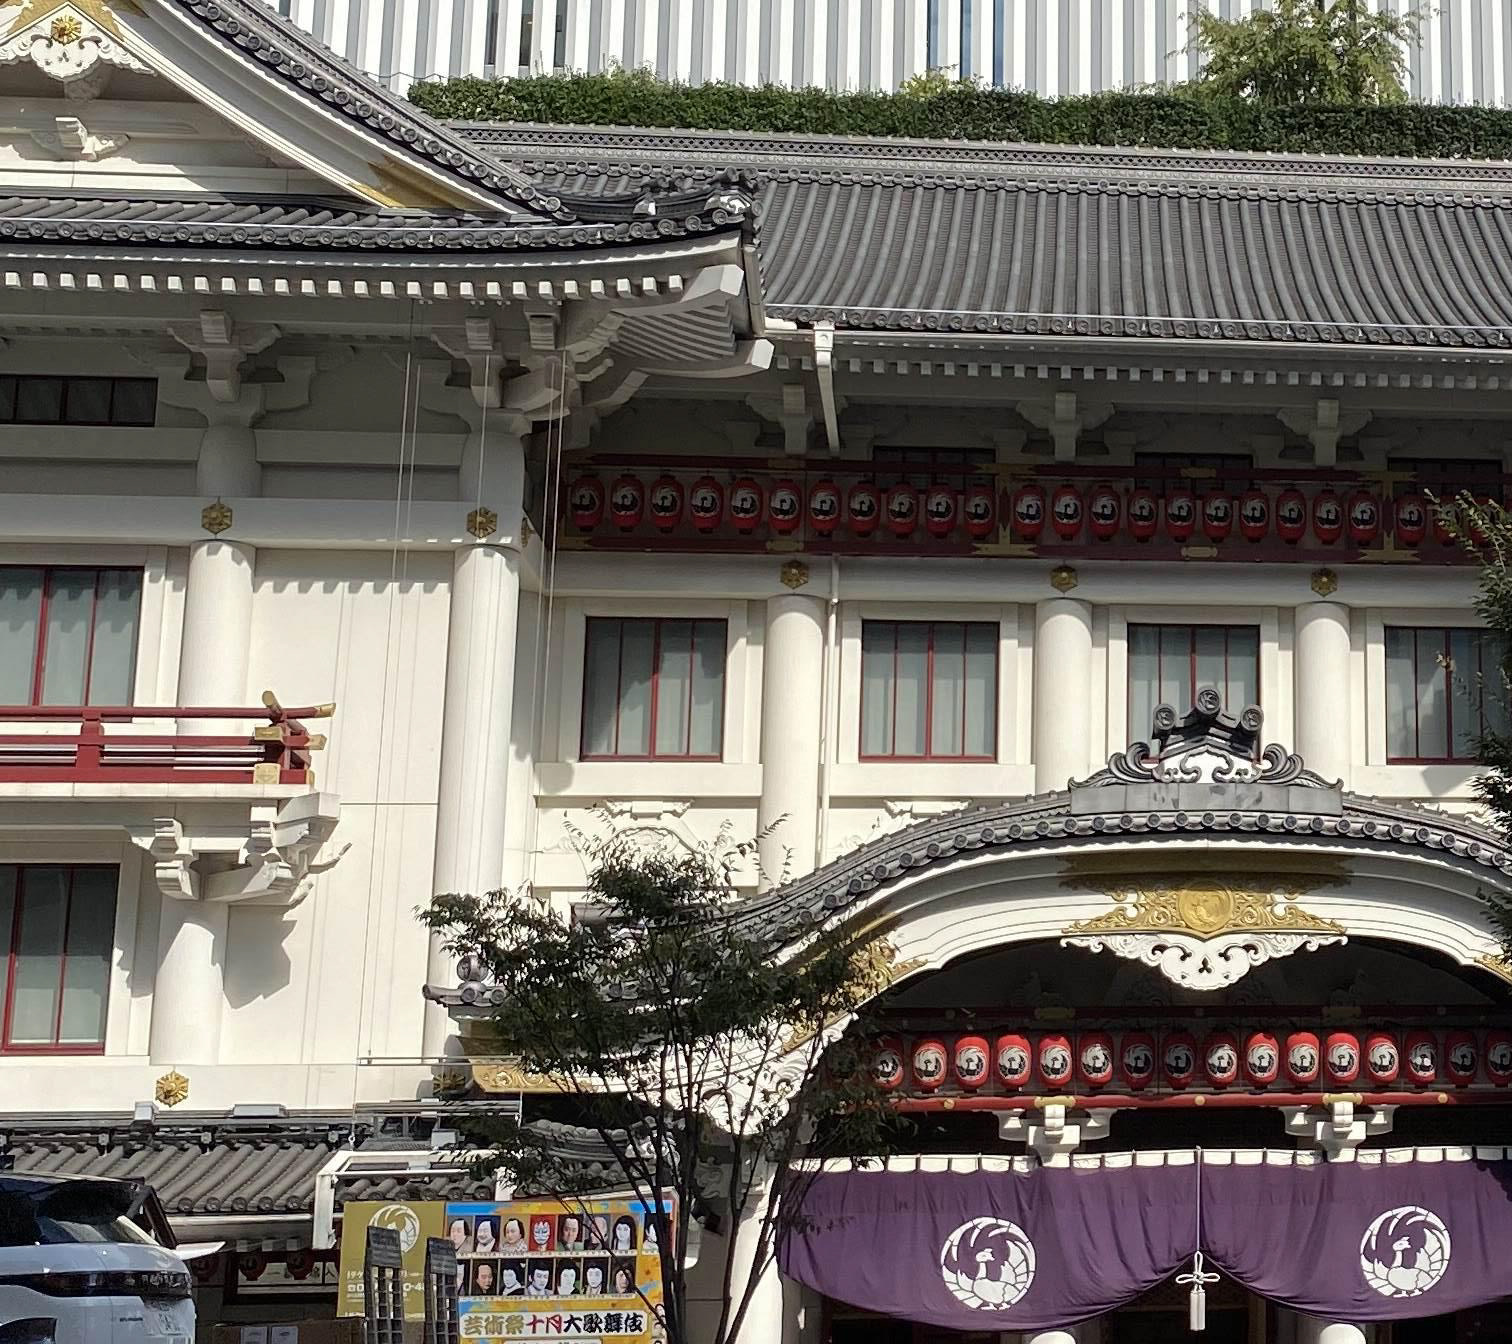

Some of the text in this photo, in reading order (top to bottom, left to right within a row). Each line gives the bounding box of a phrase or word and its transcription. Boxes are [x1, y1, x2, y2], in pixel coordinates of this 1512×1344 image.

[464, 1312, 643, 1335] 芸術祭十月大歌舞伎
